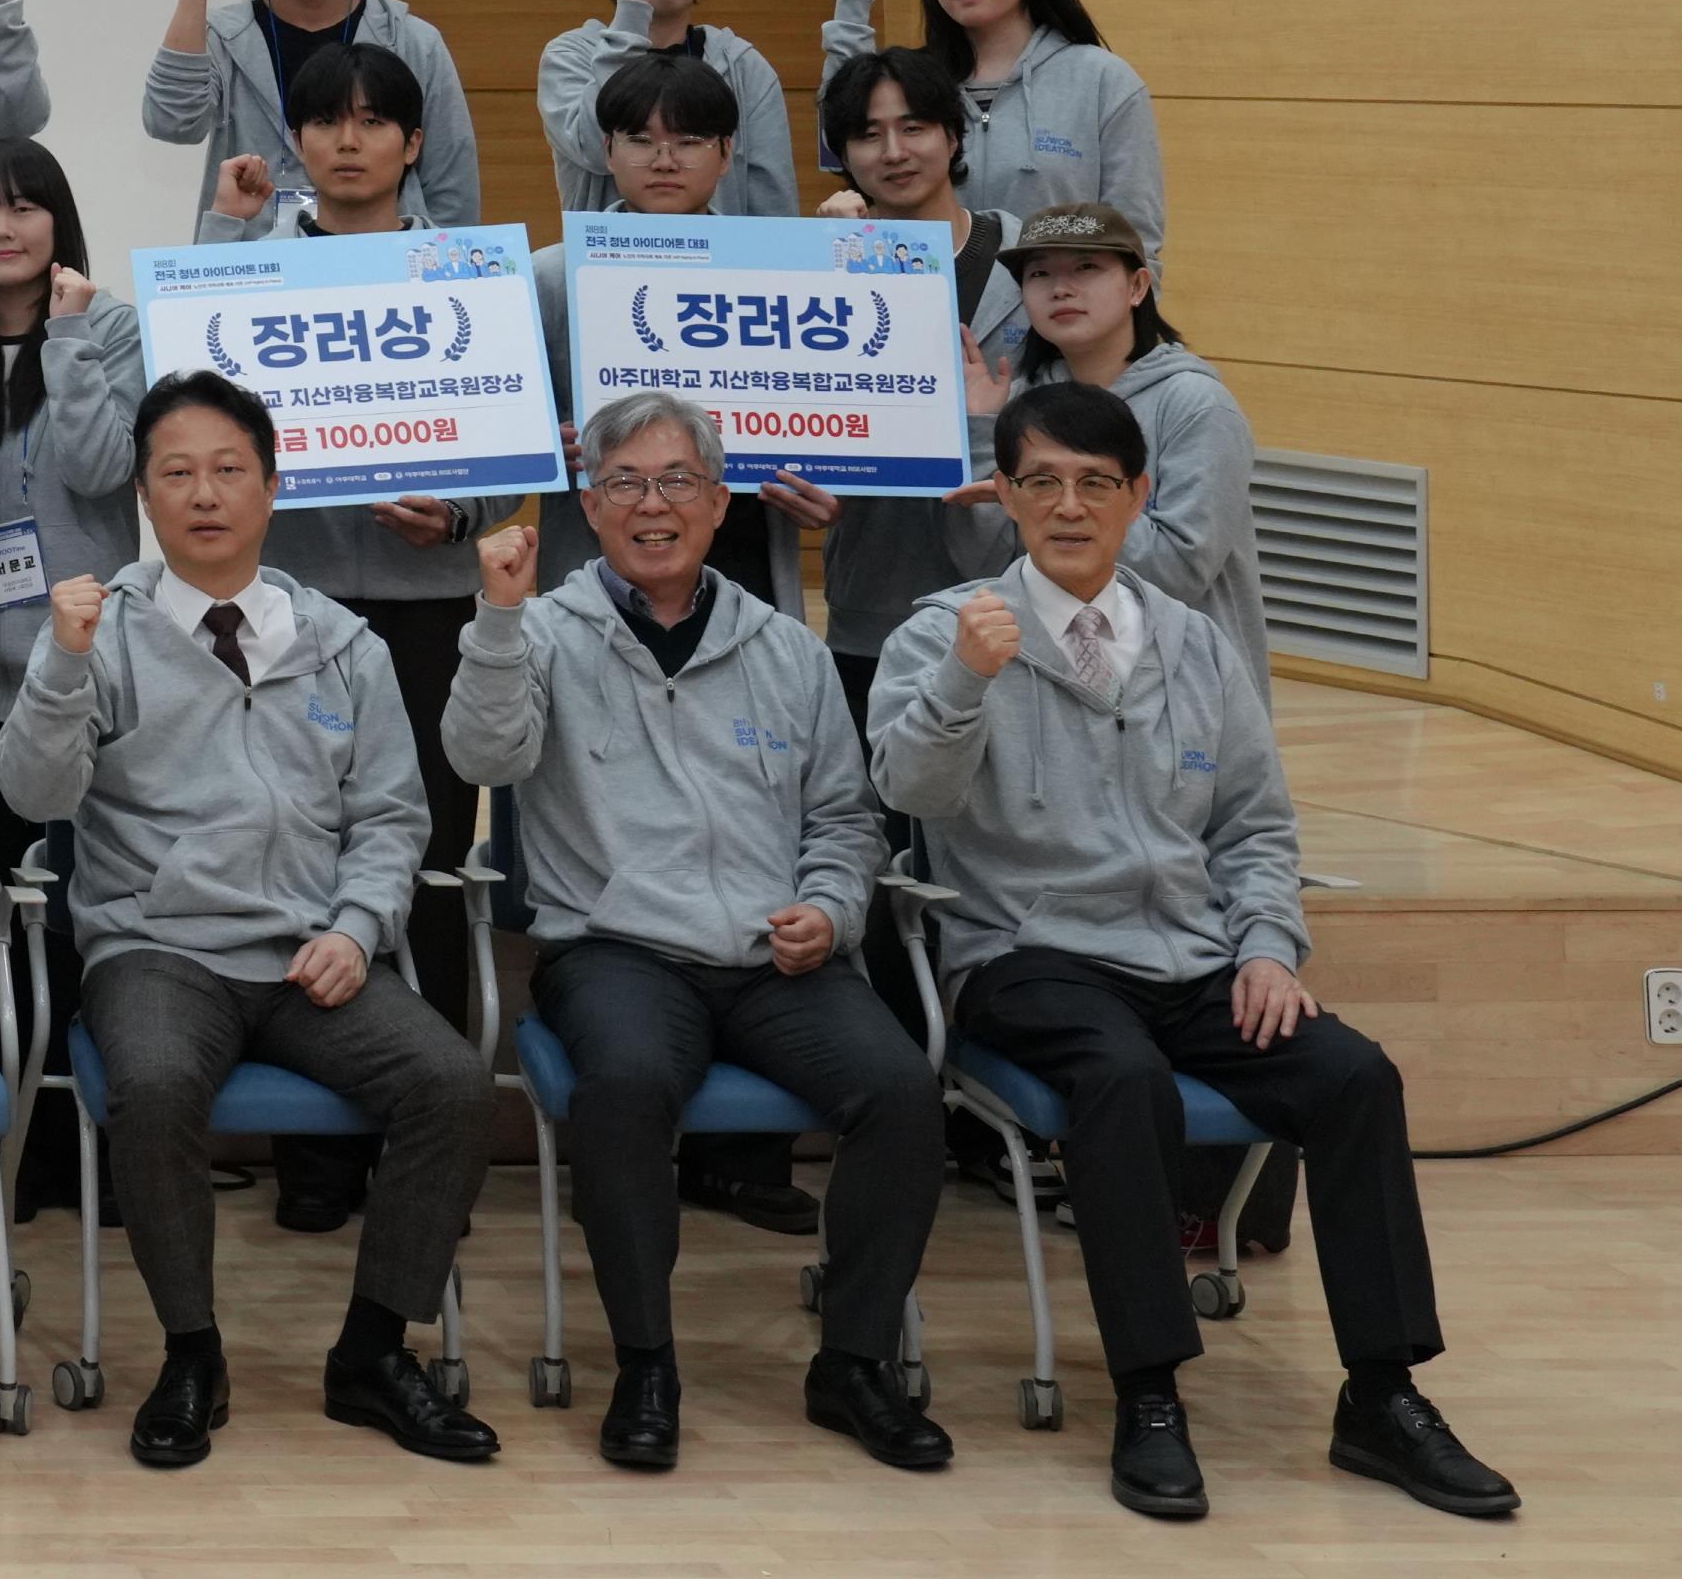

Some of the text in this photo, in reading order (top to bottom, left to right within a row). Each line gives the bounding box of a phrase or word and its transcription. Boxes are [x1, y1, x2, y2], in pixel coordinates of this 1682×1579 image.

[586, 236, 709, 249] 전국 청년 아이디어톤 대회
[155, 262, 281, 281] 전국 청년 아이디어톤 대회
[251, 305, 433, 369] 장려상
[676, 292, 854, 352] 장려상
[291, 373, 524, 409] 지산학융복합교육원장상
[598, 366, 937, 396] 아주대학교 지산학융복합교육원장상
[316, 417, 459, 451] 100,000원
[731, 411, 870, 439] 100,000원
